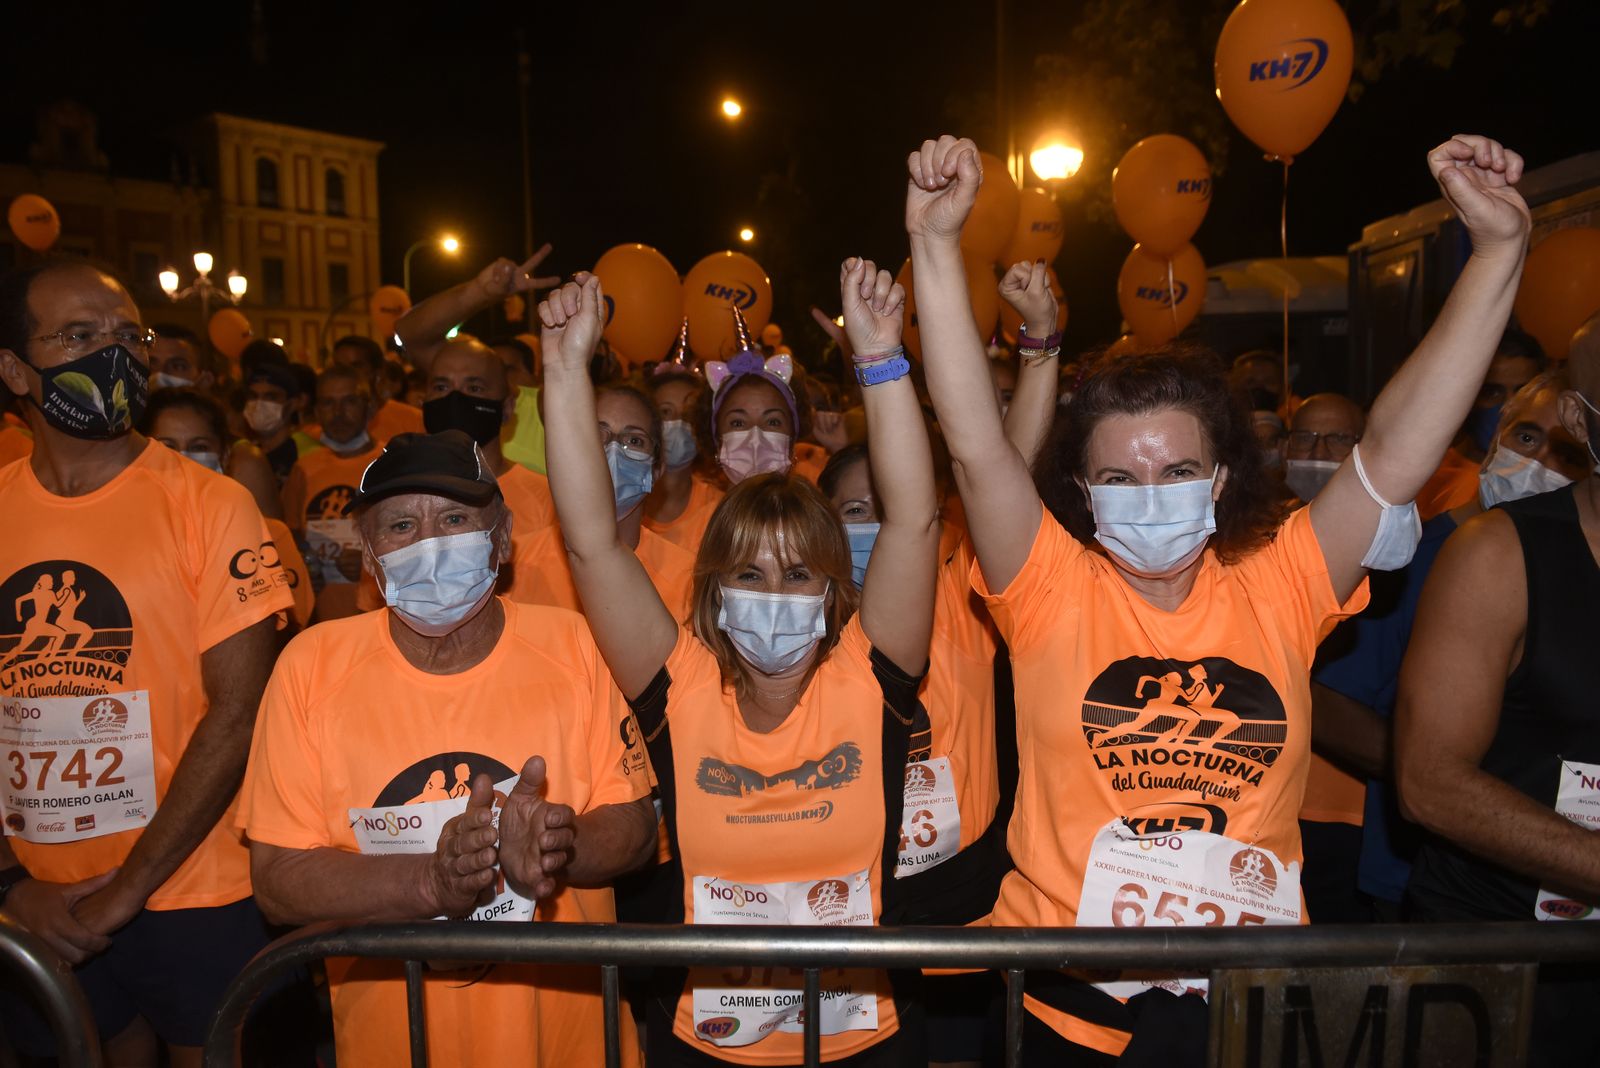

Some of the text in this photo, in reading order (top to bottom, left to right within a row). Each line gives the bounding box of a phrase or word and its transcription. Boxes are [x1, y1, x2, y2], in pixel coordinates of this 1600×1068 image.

[20, 661, 124, 685] NOCTURNA
[72, 736, 118, 744] GUADALQUIVIR
[8, 746, 125, 791] 3742
[1093, 748, 1265, 787] LA NOCTURNA
[1112, 771, 1241, 801] del Guadalquivir
[43, 796, 91, 809] ROMERO
[94, 789, 134, 804] GALAN
[124, 807, 144, 815] ABC
[916, 852, 940, 865] LUNA
[1109, 847, 1149, 861] AYUNTAMIENTO
[1094, 860, 1115, 872] XXXIII
[1116, 865, 1150, 880] CARRERA
[1210, 888, 1265, 910] GUADALQUIVIR
[1266, 904, 1281, 914] KH7
[1282, 909, 1299, 919] 2021
[477, 899, 515, 921] LOPEZ
[820, 904, 848, 912] NOCTURNA
[720, 995, 771, 1007] CARMEN
[819, 984, 852, 1002] PAVON
